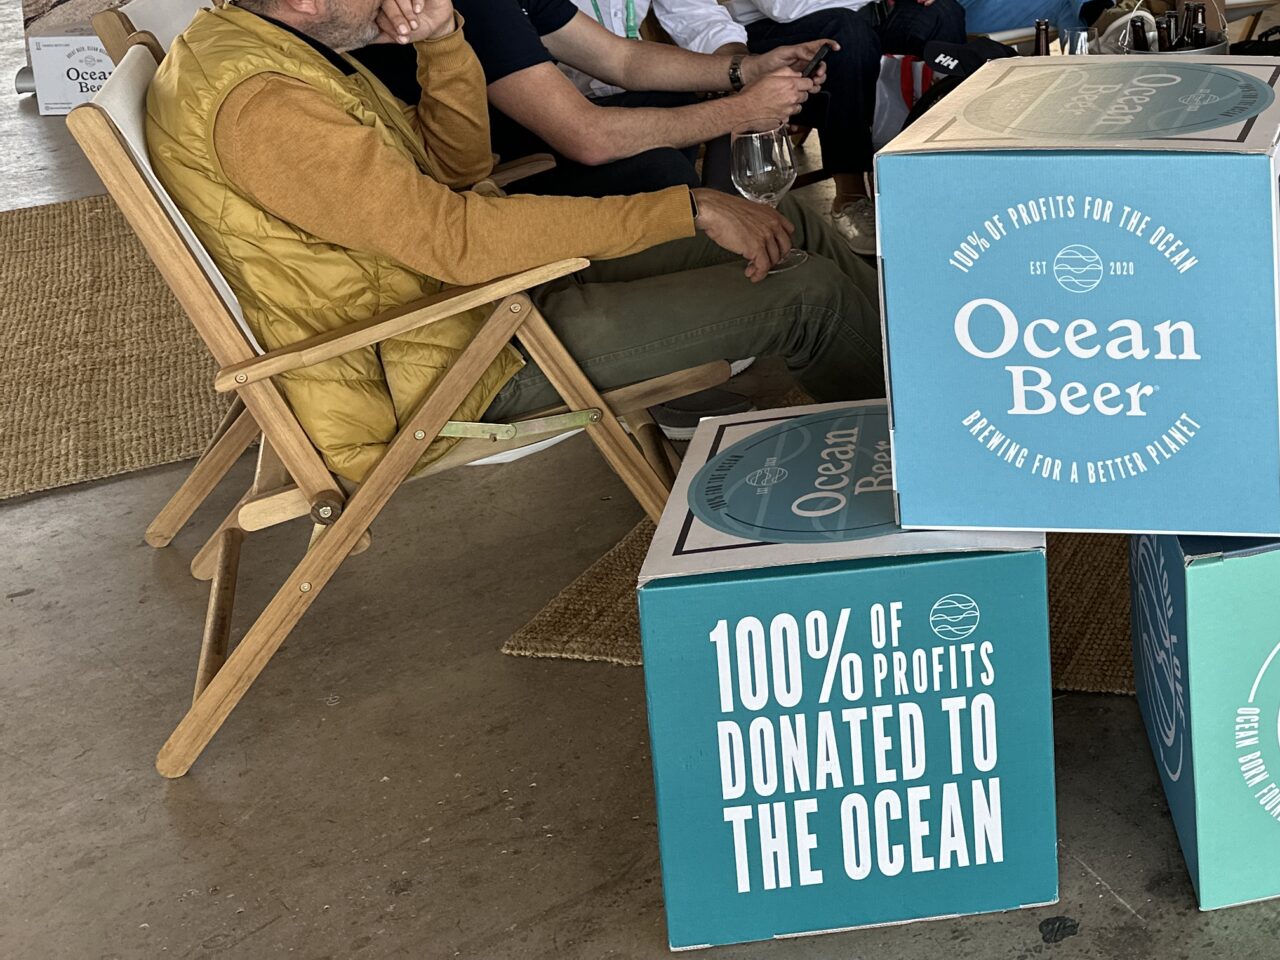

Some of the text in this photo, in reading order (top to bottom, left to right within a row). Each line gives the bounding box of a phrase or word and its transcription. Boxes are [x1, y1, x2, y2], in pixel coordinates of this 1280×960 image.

[78, 81, 103, 93] Bee
[934, 53, 959, 70] HH
[1063, 83, 1124, 113] Beer
[1096, 73, 1182, 125] Ocean
[948, 195, 1199, 274] 100% OF PROFITS FOR THE OCEAN
[1030, 261, 1134, 275] EST 2020
[953, 297, 1201, 361] Ocean
[1005, 365, 1154, 416] Beer
[791, 427, 859, 517] Ocean
[854, 440, 893, 496] Beer
[961, 409, 1201, 484] BREWING FOR A BETTER PLANET
[708, 600, 904, 714] 100% OF
[1160, 544, 1186, 729] YOU LOVE
[873, 640, 996, 699] PROFITS
[715, 691, 998, 801] DONATED TO
[1235, 707, 1261, 749] OCEAN
[1238, 751, 1270, 788] BORN
[722, 776, 1005, 894] THE OCEAN
